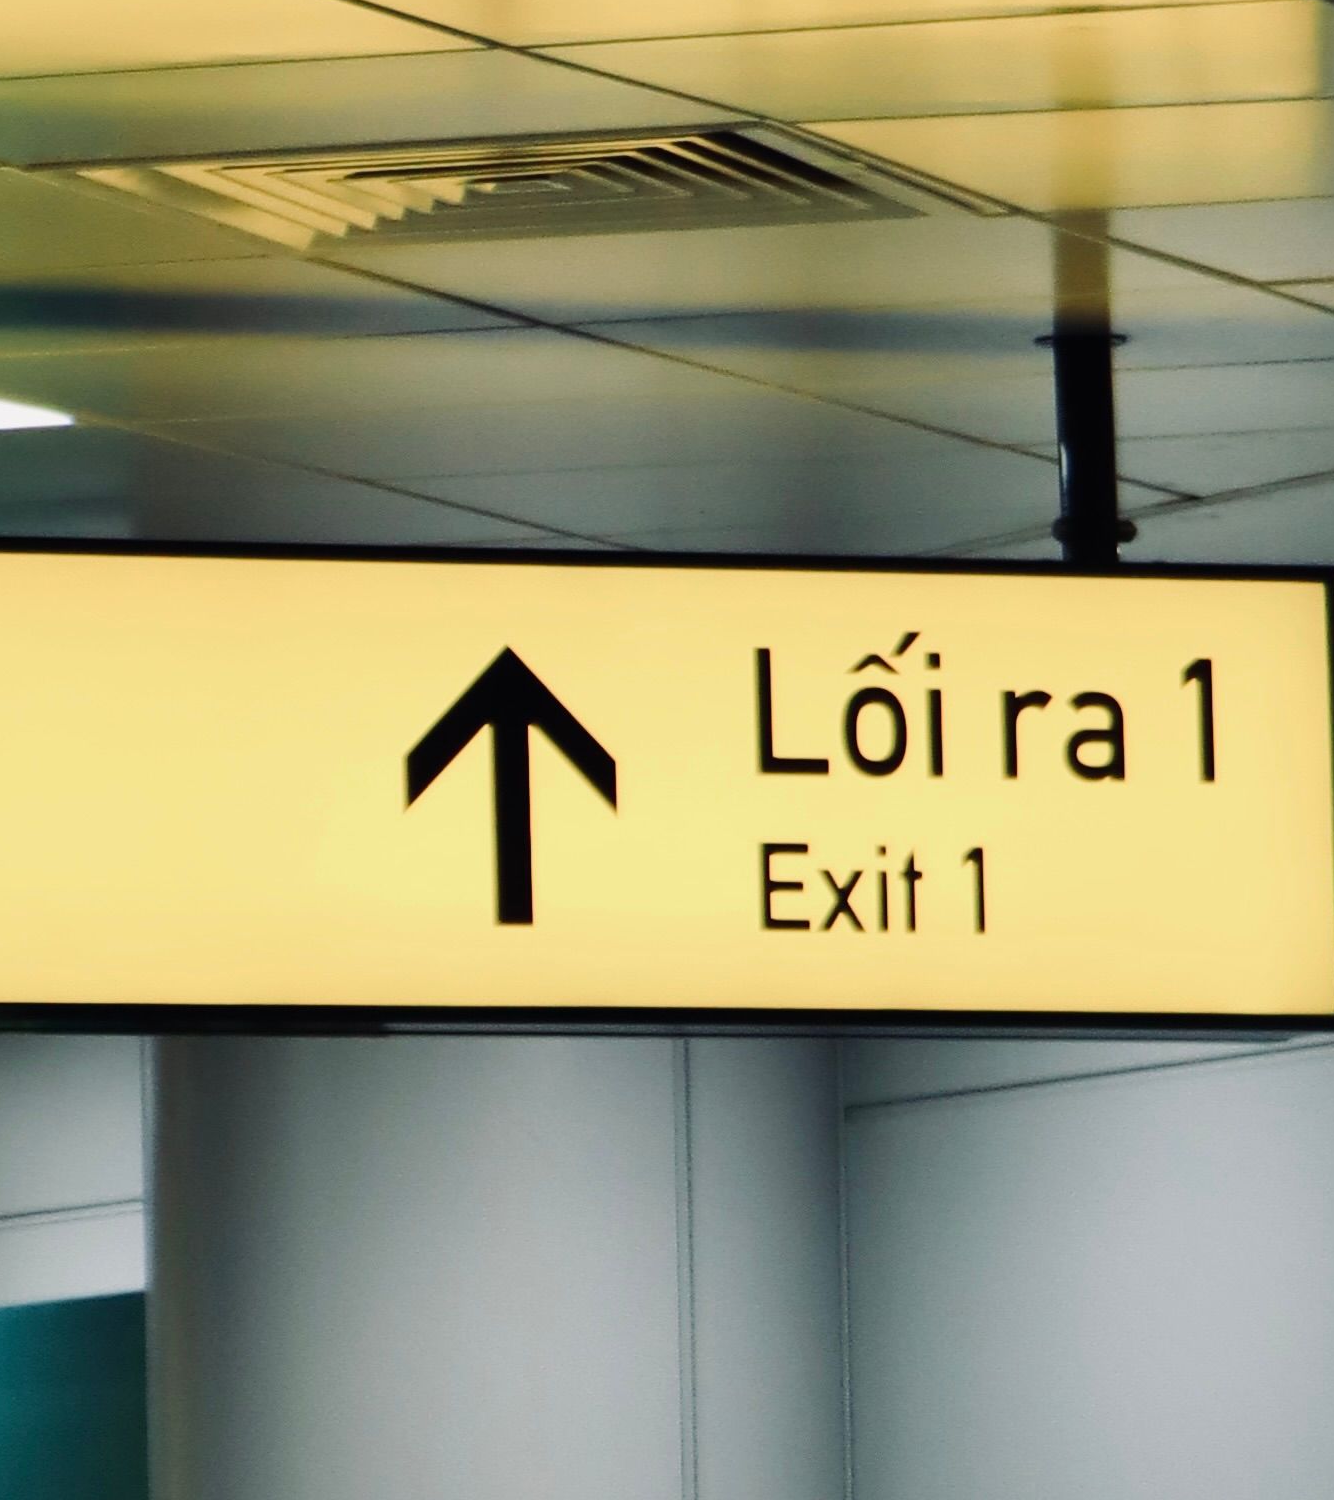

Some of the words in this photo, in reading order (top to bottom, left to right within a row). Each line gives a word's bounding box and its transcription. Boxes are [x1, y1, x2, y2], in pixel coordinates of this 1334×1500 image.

[754, 631, 944, 779] Lối
[1001, 686, 1126, 782] ra
[1181, 658, 1217, 783] 1
[762, 842, 924, 934] Exit
[961, 846, 988, 934] 1
